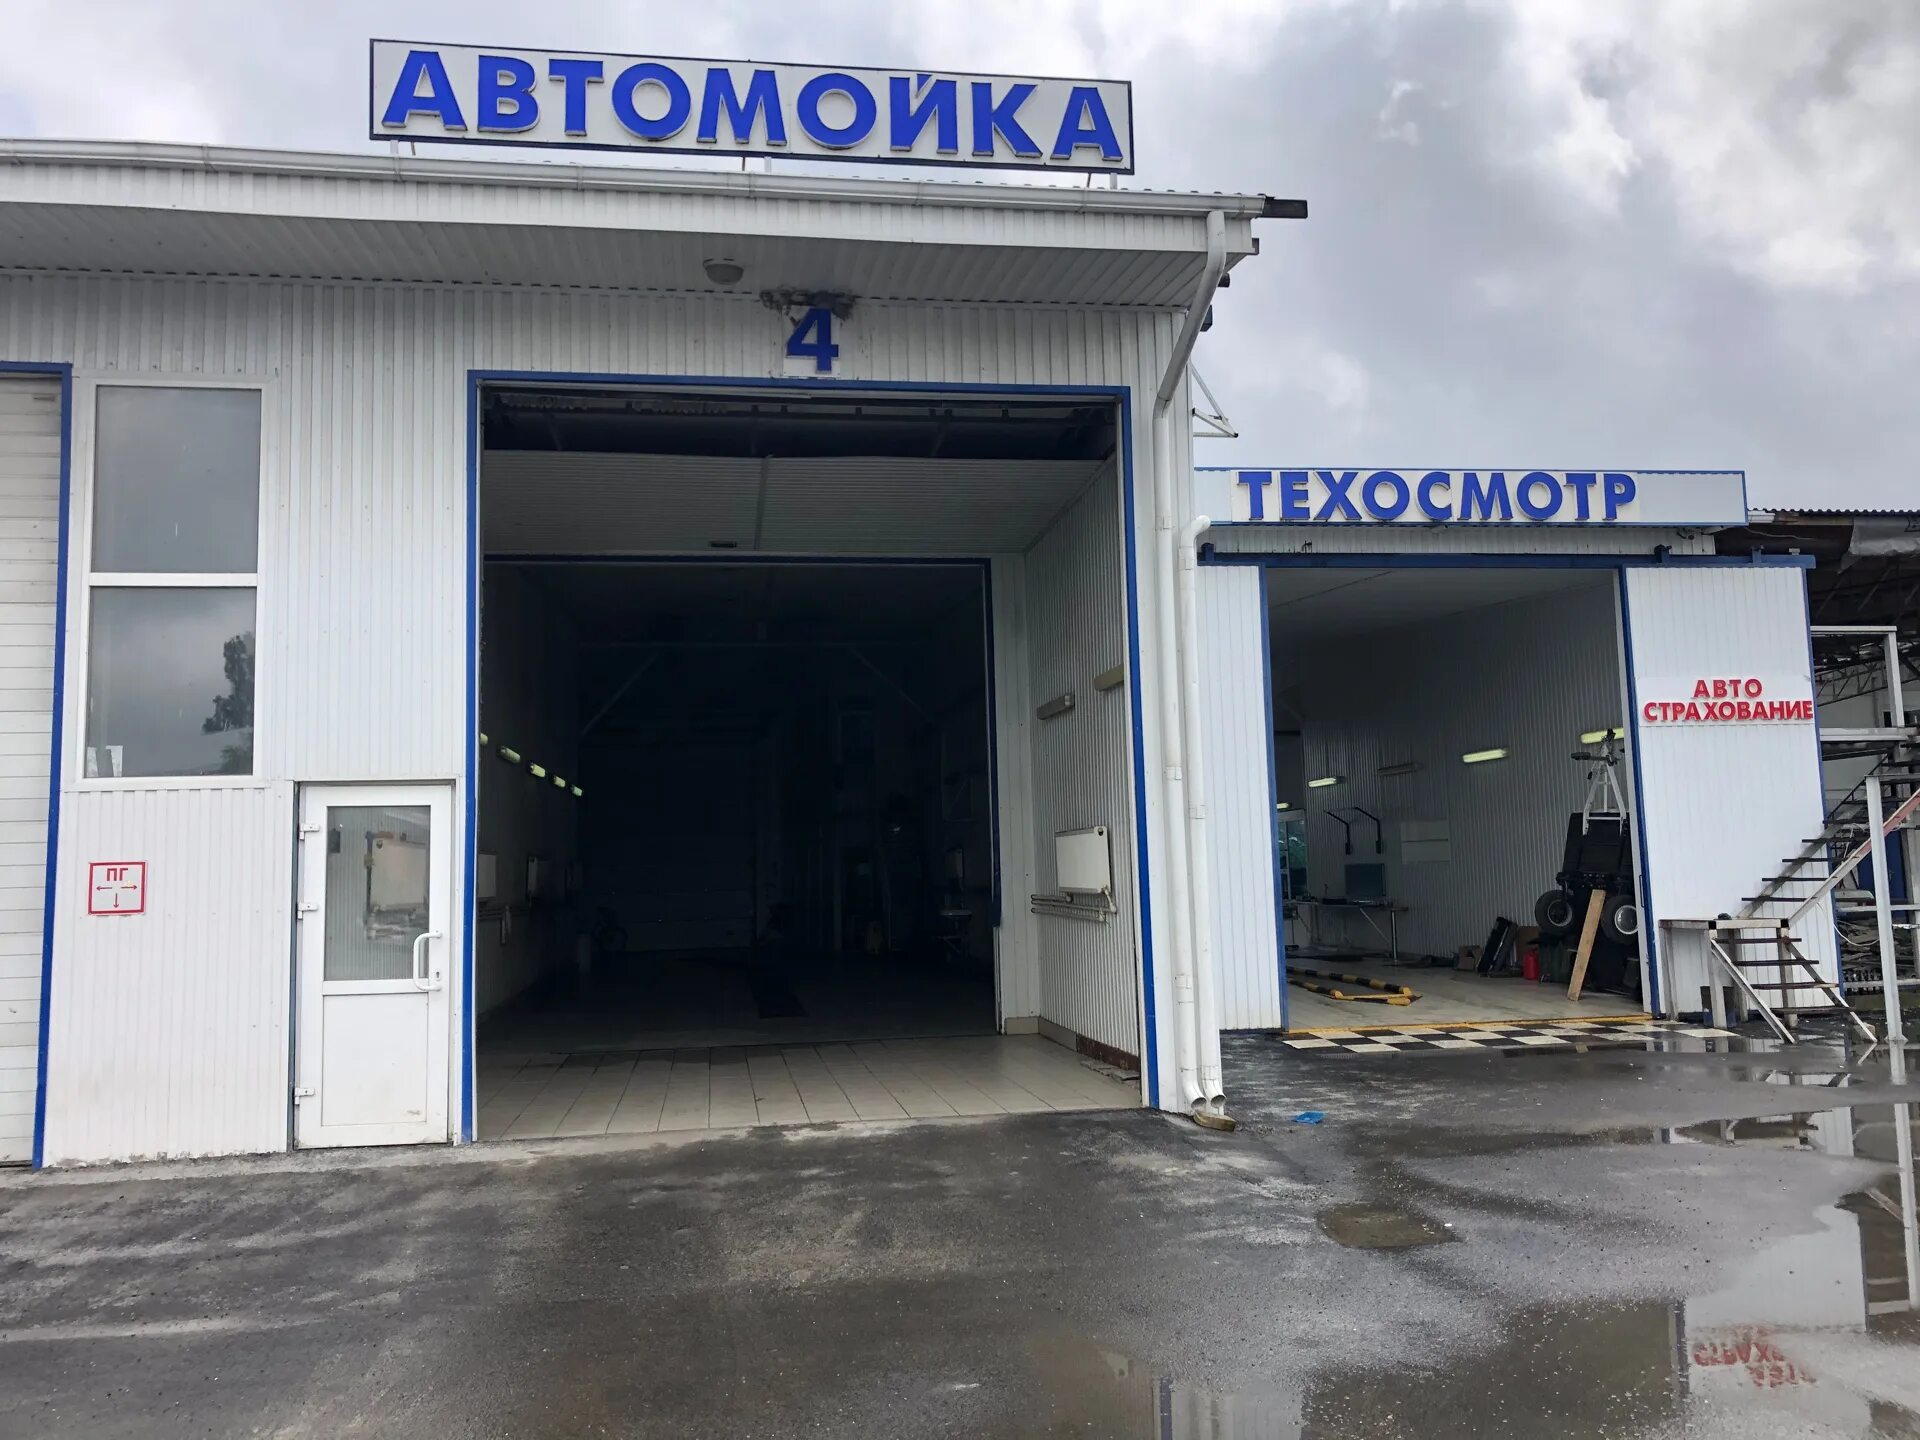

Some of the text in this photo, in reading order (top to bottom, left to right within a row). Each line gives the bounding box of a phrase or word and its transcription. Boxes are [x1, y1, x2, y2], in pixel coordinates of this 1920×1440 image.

[381, 49, 1124, 161] АВТОМОЙКА
[786, 307, 839, 371] 4
[1236, 470, 1637, 520] ТЕХОСМОТР
[1693, 678, 1763, 699] АВТО
[1643, 700, 1814, 722] СТРАХОВАНИЕ
[106, 867, 129, 881] ПГ
